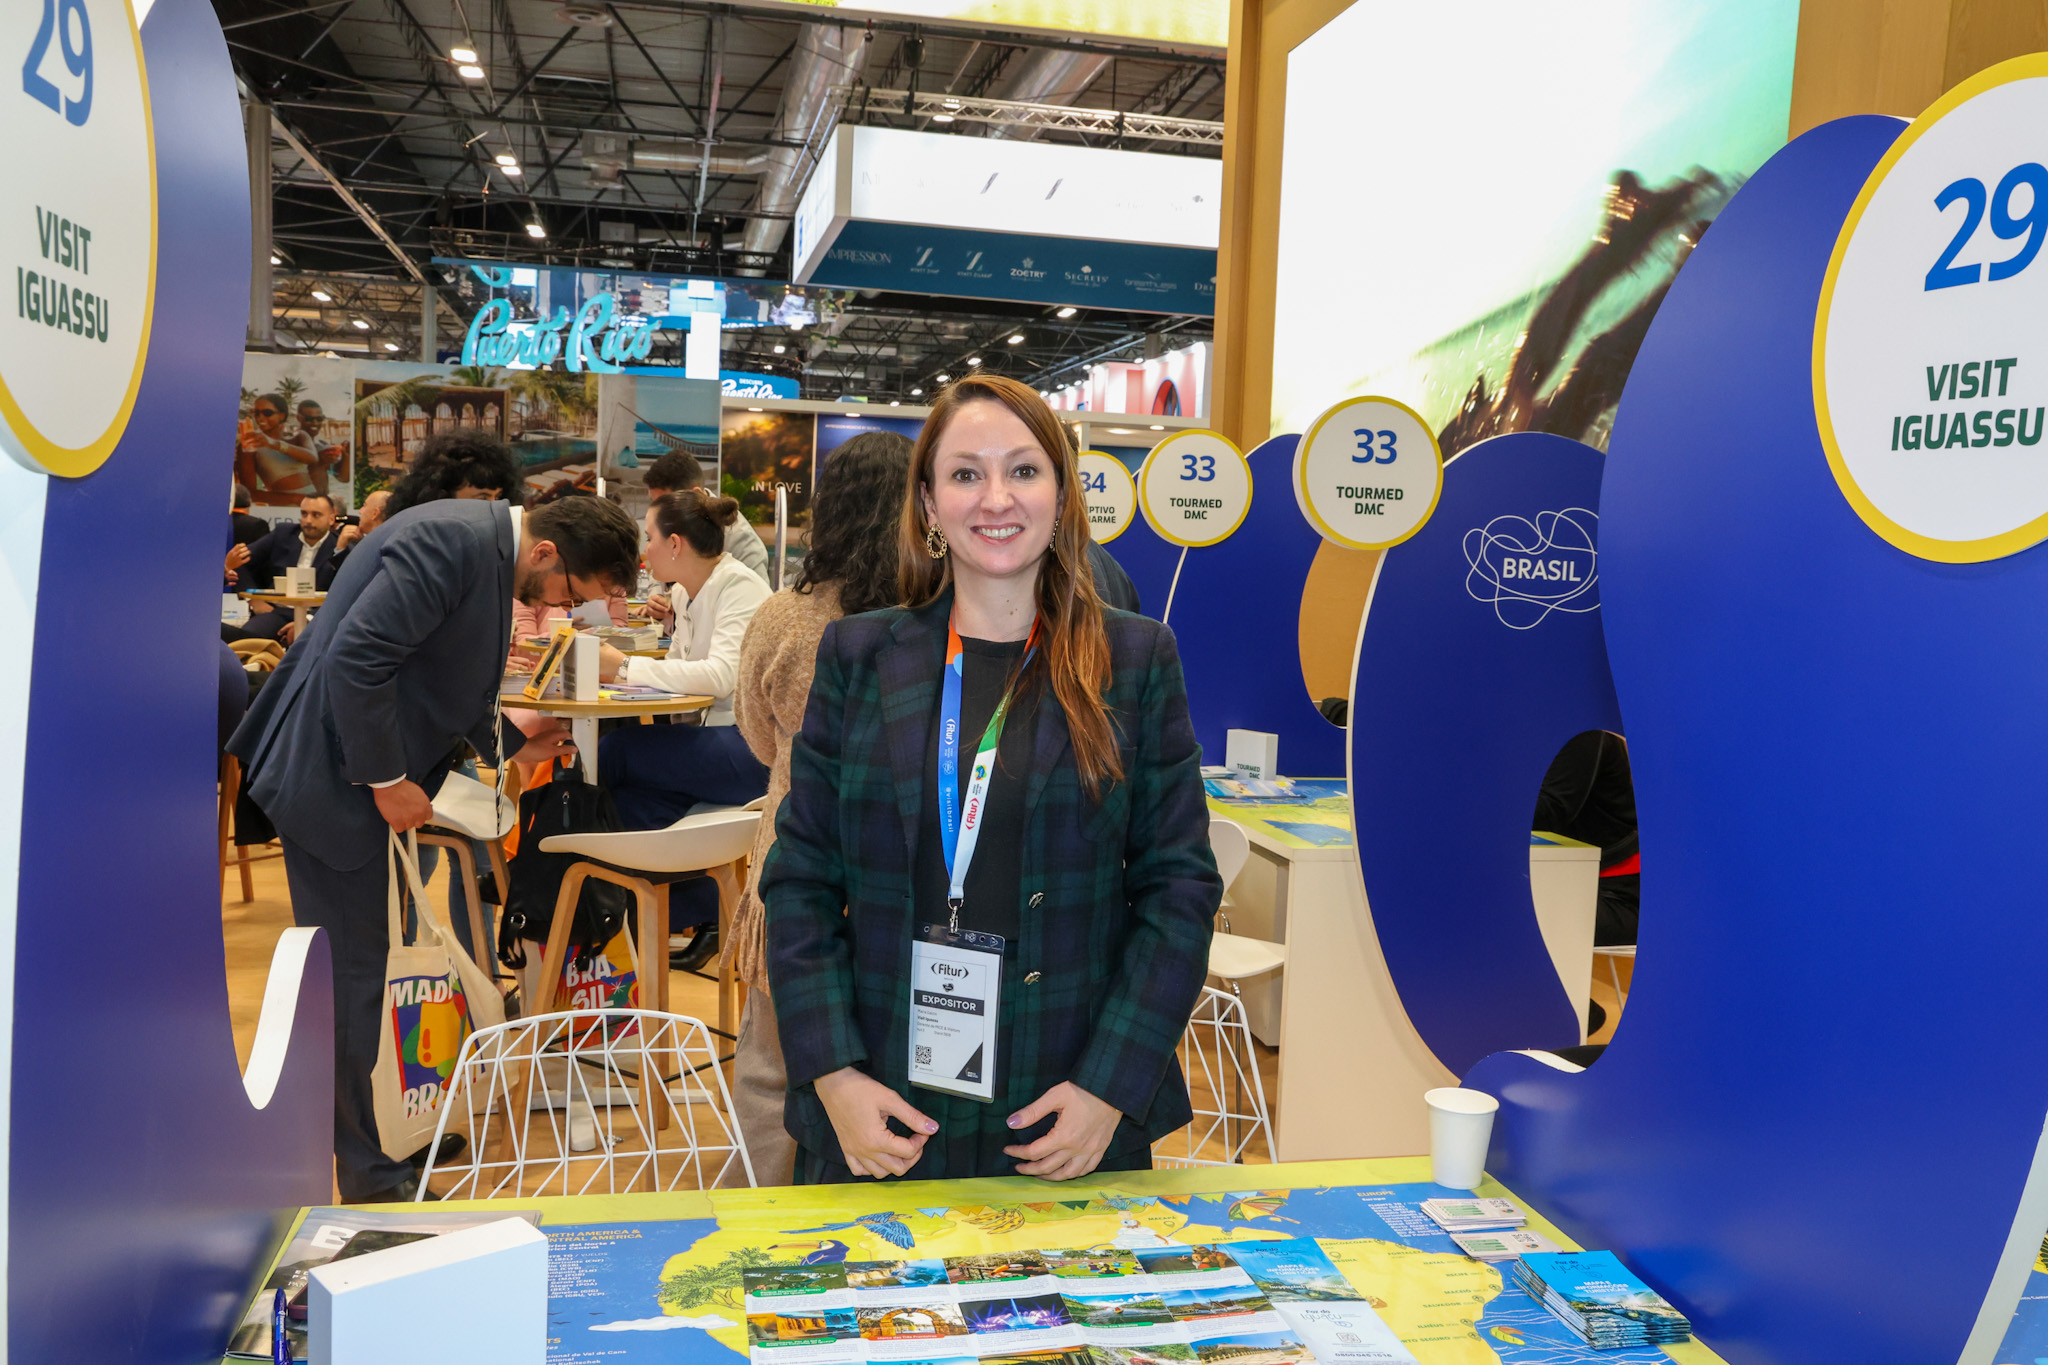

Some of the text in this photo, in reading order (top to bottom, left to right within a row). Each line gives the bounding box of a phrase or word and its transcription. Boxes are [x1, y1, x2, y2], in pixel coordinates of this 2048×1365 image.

[22, 0, 94, 127] 29
[1924, 161, 2048, 292] 29
[36, 205, 92, 276] VISIT
[17, 266, 109, 344] IGUASSU
[461, 293, 663, 375] Puerto Rico
[1926, 357, 2019, 402] VISIT
[1891, 406, 2046, 452] IGUASSU
[1352, 428, 1398, 466] 33
[1180, 454, 1216, 482] 33
[750, 481, 765, 492] IN
[1079, 472, 1107, 493] 34
[1170, 497, 1223, 509] TOURMED
[1336, 485, 1404, 502] TOURMED
[1089, 506, 1115, 514] PTIVO
[1184, 510, 1208, 520] DMC
[1354, 502, 1385, 517] DMC
[1089, 515, 1117, 524] ARME
[1502, 557, 1581, 583] BRASIL
[1237, 763, 1261, 773] TOURMED
[1249, 772, 1260, 780] DMC
[922, 994, 977, 1012] EXPOSITOR
[577, 1229, 628, 1237] AMERICA
